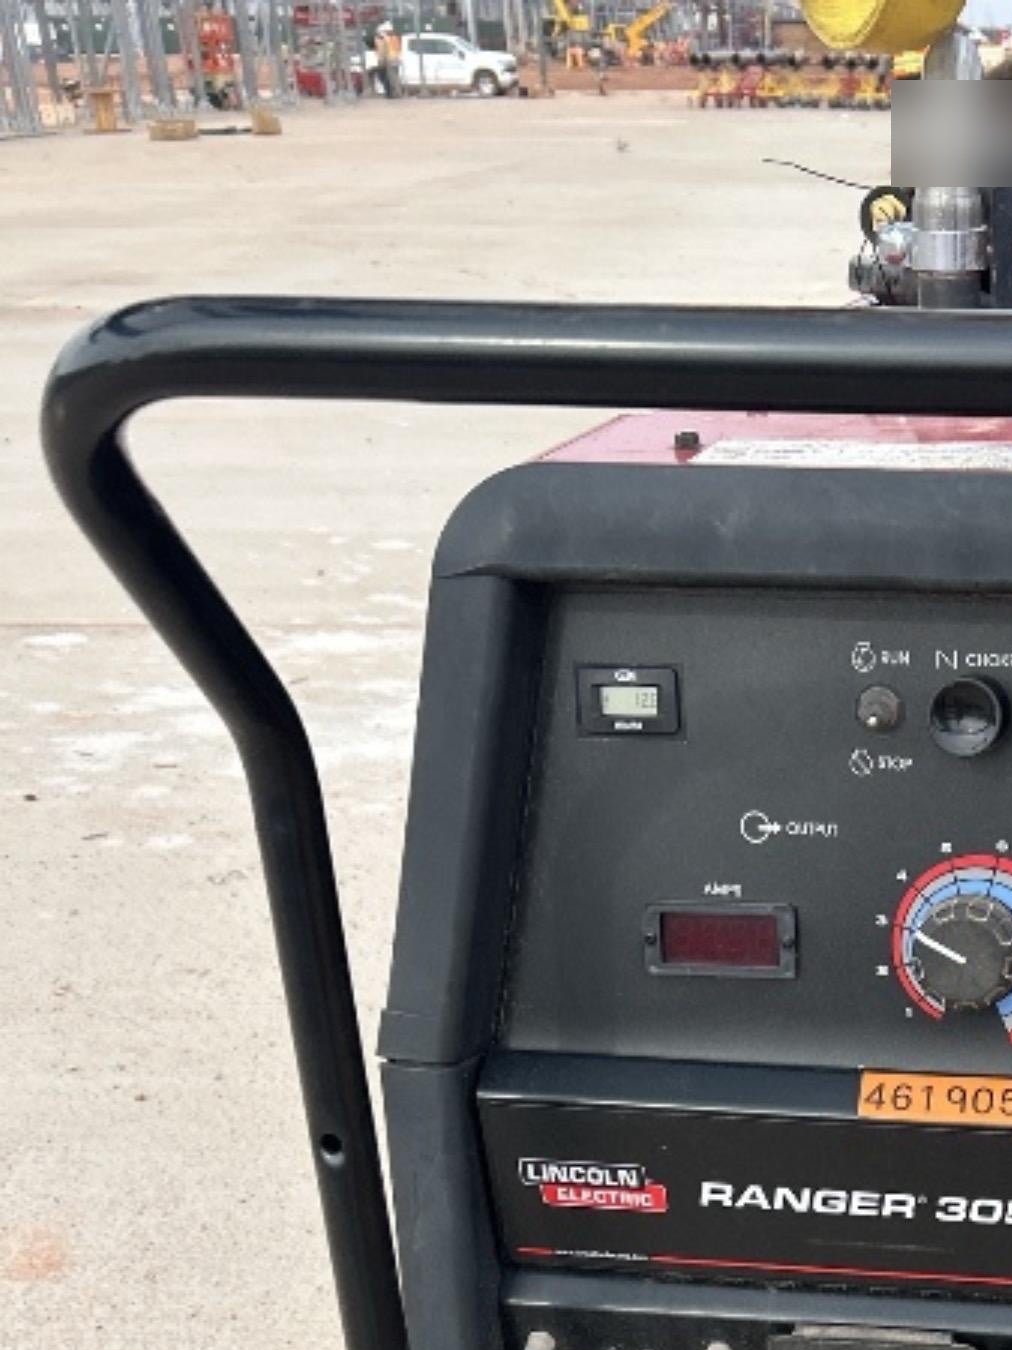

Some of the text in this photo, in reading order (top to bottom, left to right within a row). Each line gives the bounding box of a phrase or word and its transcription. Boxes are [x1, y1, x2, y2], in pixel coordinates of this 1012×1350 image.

[881, 650, 911, 667] RUN
[877, 755, 913, 771] STOP
[786, 821, 838, 837] OUTPUT
[526, 1163, 640, 1188] LINCOLN
[556, 1187, 654, 1208] ELECTRIC
